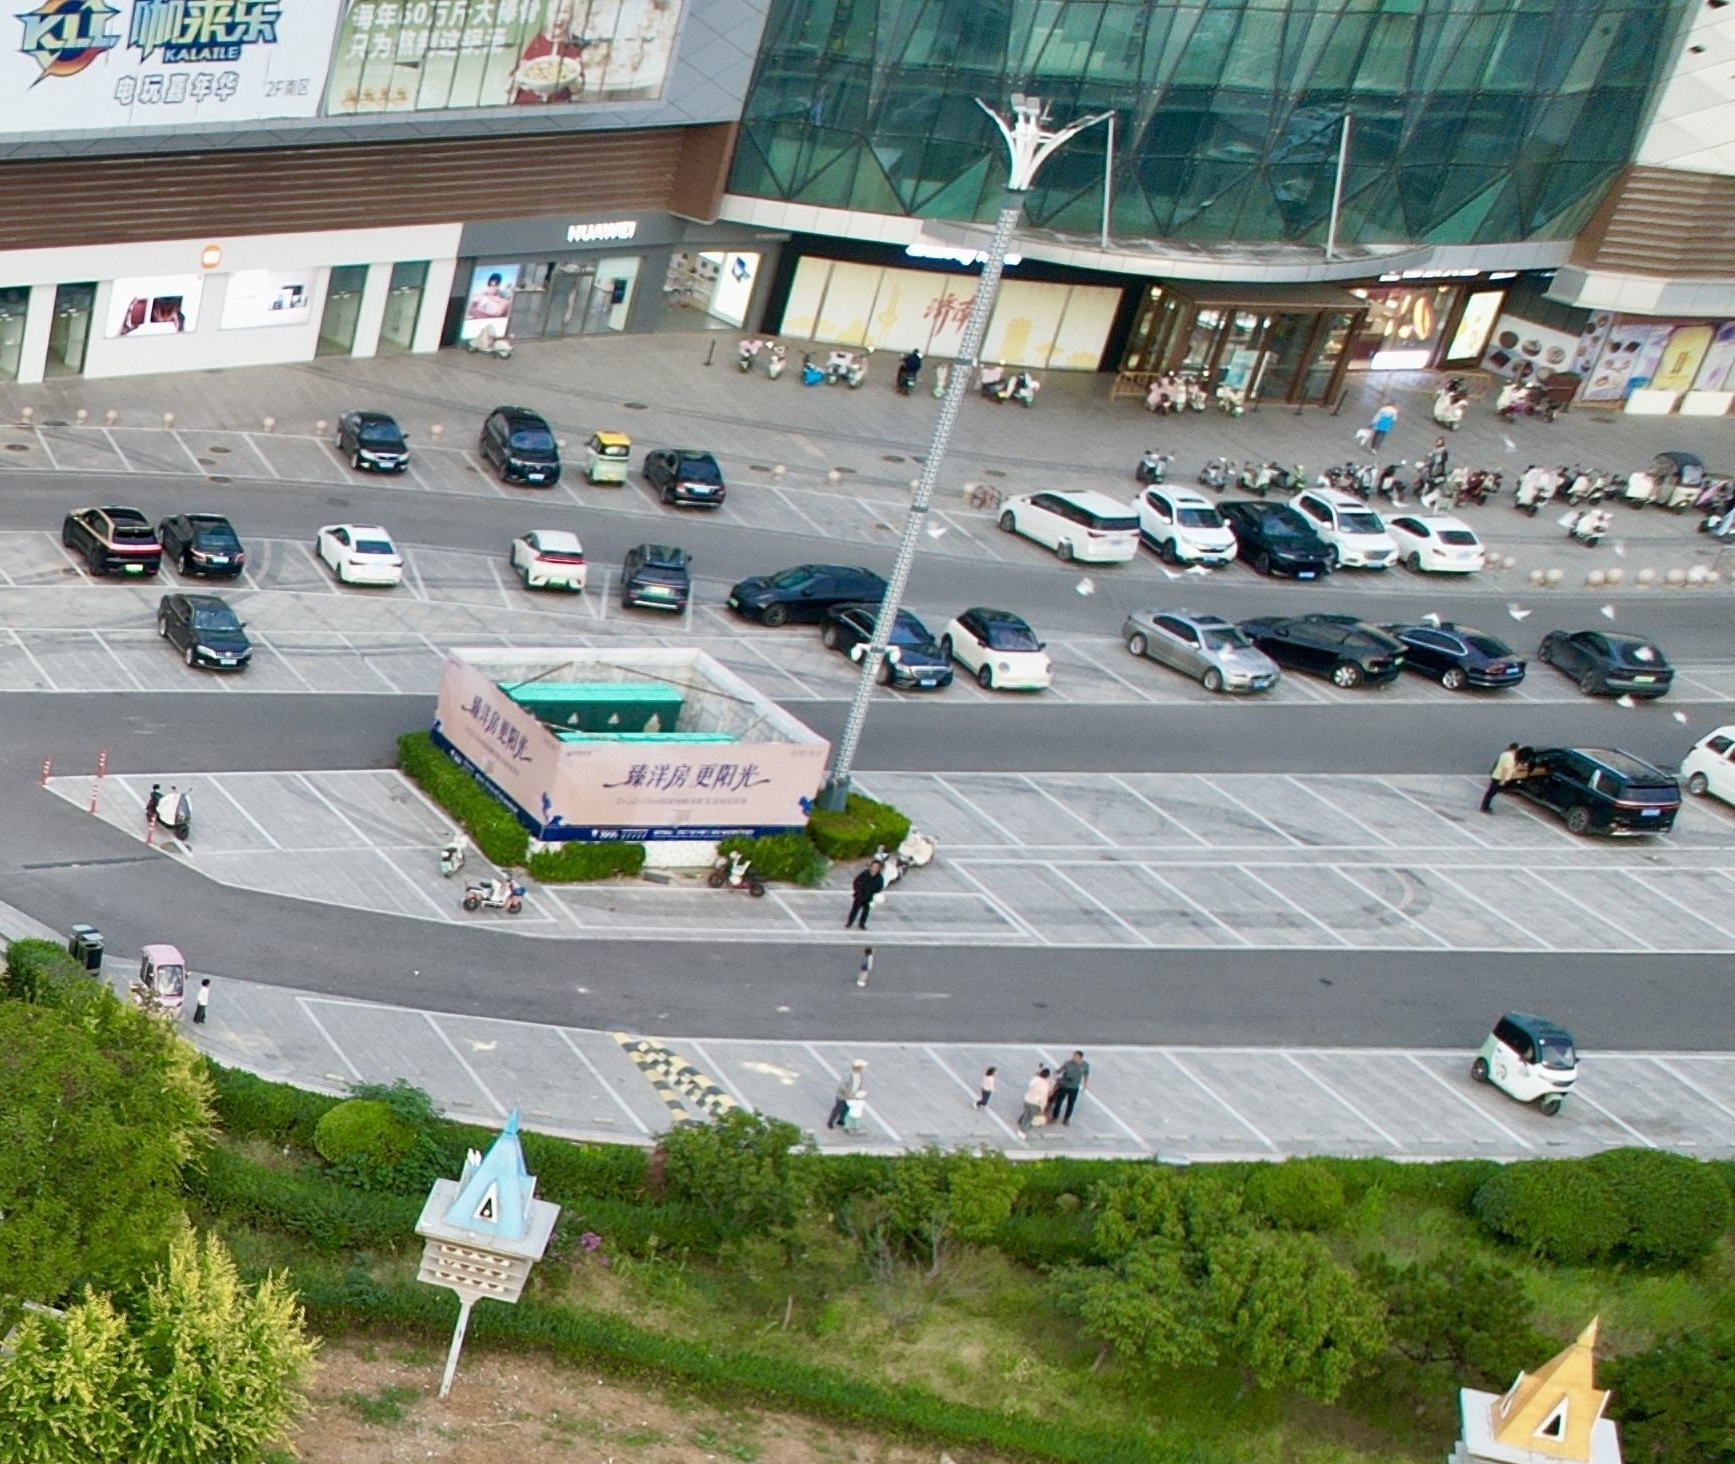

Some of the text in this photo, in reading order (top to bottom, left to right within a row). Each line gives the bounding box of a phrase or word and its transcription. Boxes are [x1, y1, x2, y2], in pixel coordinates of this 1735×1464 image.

[164, 46, 241, 63] KALAILE
[115, 71, 239, 105] 电玩嘉年华
[567, 220, 637, 243] HUAWEI
